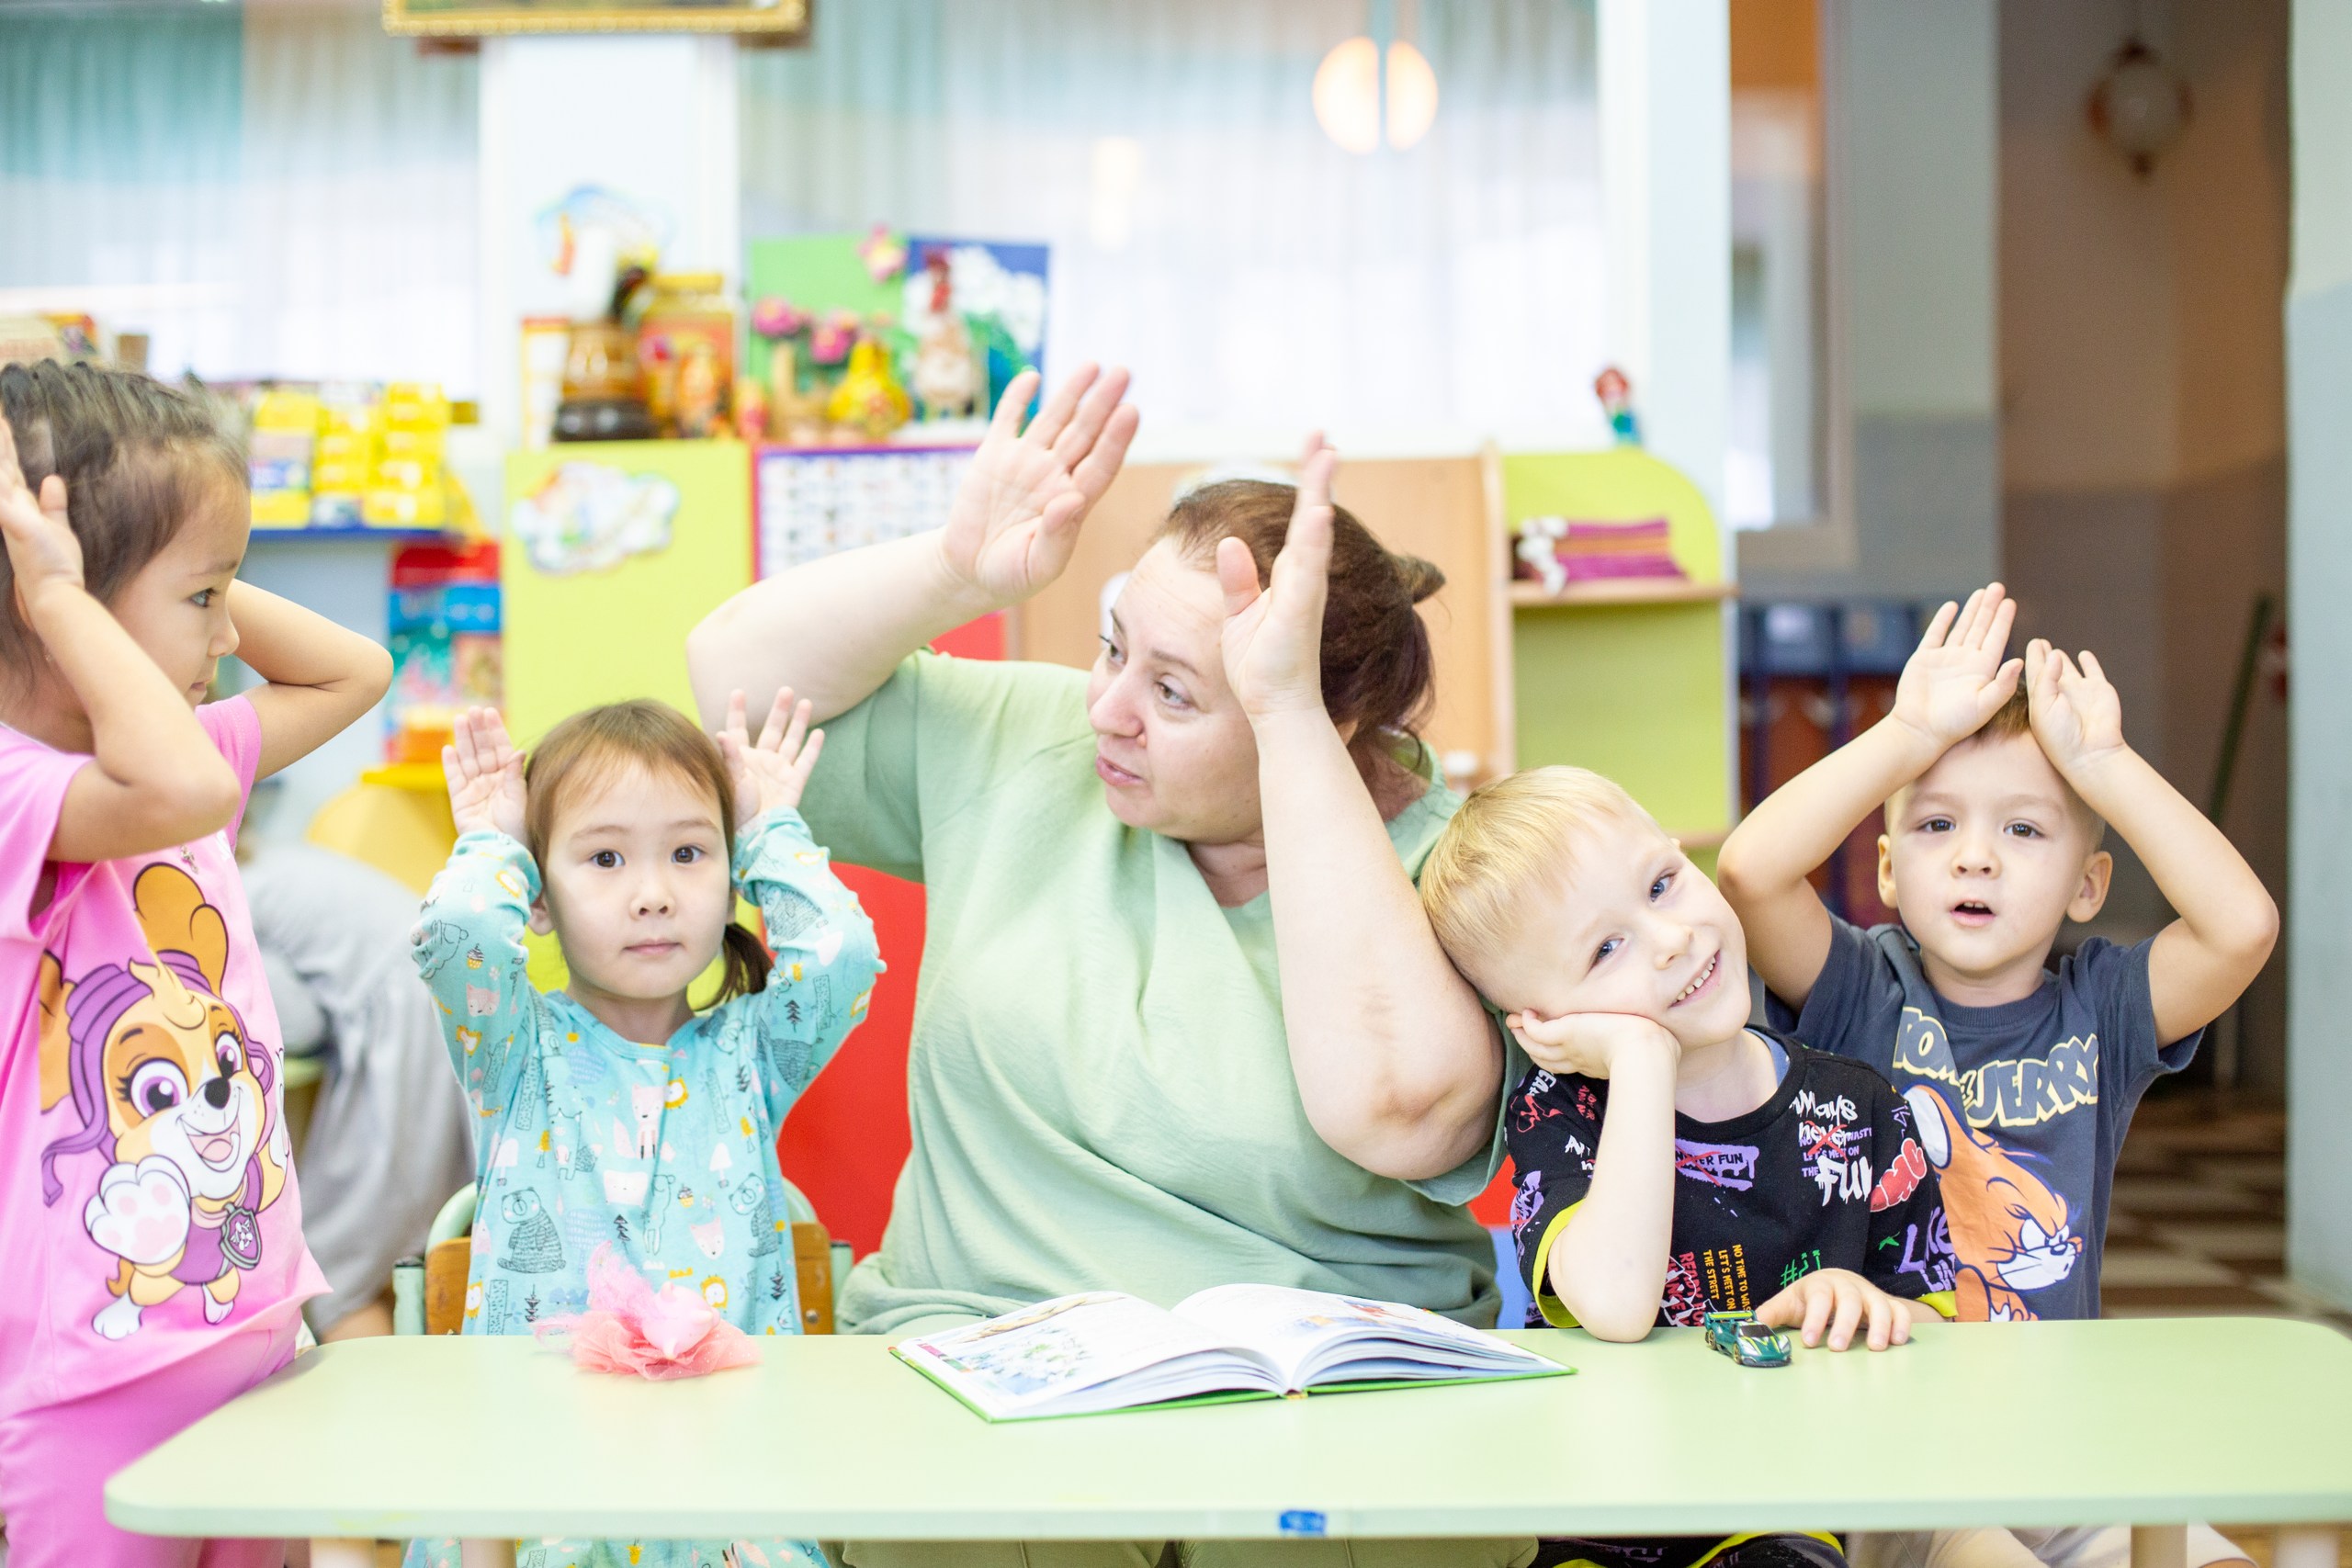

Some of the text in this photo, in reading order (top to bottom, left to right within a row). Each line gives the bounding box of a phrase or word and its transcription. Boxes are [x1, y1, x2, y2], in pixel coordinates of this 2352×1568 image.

[1965, 1032, 2099, 1128] JERRY
[1718, 1152, 1744, 1166] FUN
[1848, 1145, 1860, 1157] ON
[1702, 1249, 1720, 1300] THE STREET
[1718, 1249, 1736, 1311] LET'S MEET ON
[1732, 1244, 1743, 1258] NO
[1739, 1280, 1748, 1292] TO
